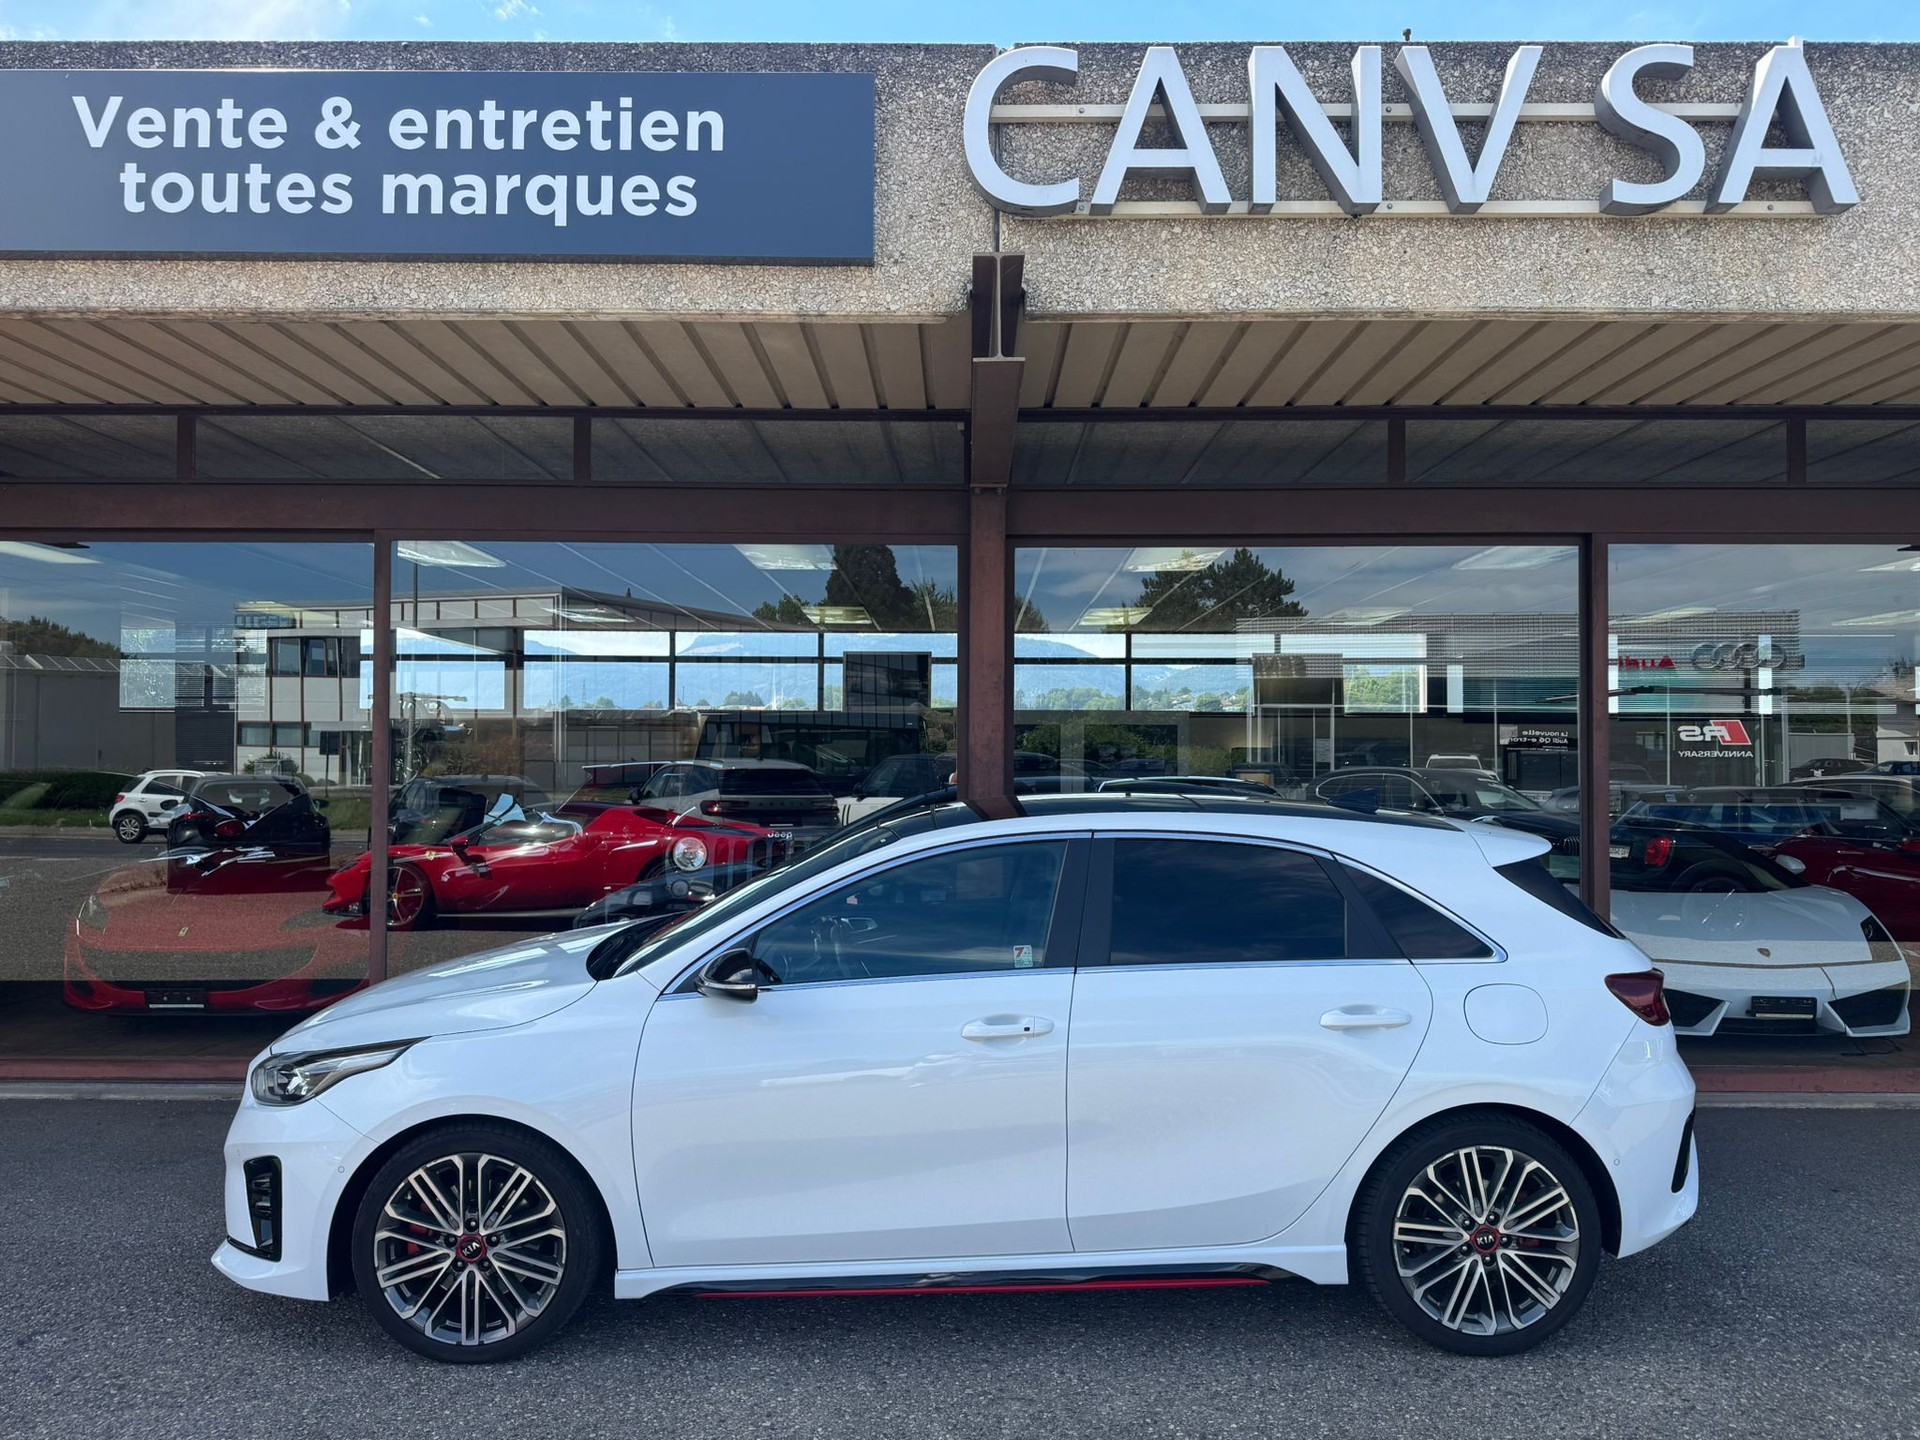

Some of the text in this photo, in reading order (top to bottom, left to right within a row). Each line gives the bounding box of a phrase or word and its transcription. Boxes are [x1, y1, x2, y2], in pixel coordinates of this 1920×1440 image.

[72, 96, 725, 152] Vente & entretien
[963, 42, 1859, 214] CANV SA
[119, 162, 698, 227] toutes marques
[767, 830, 793, 840] Jeep
[462, 1241, 480, 1256] KIA
[1476, 1235, 1495, 1245] KIA
